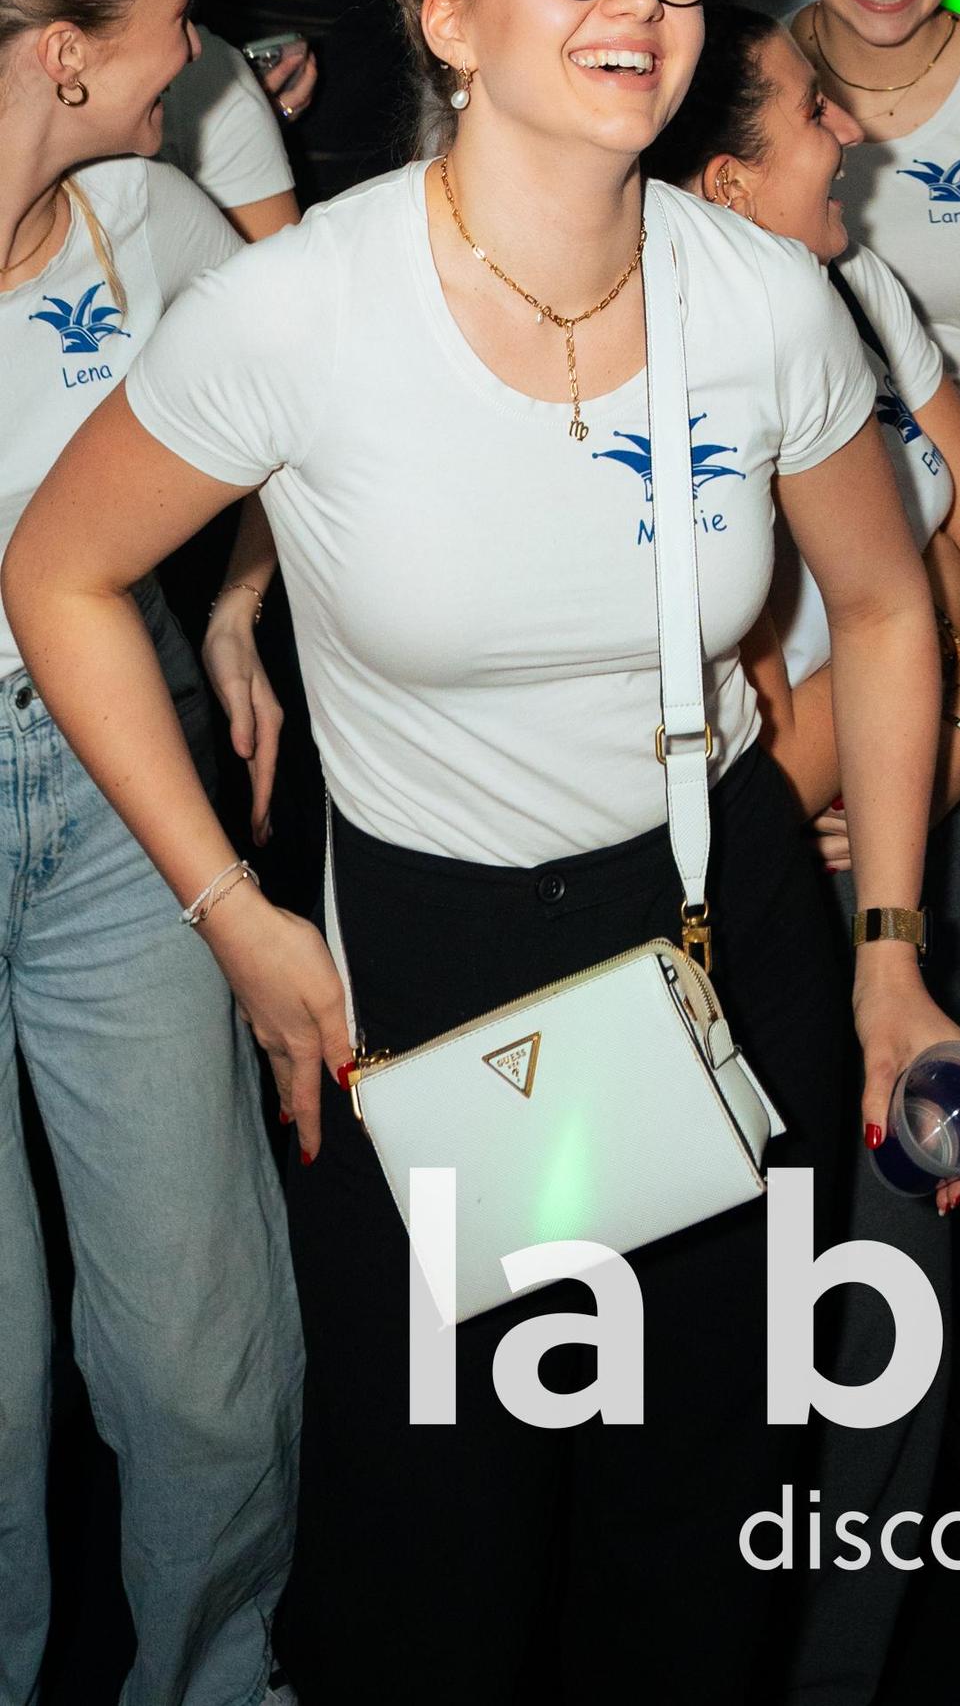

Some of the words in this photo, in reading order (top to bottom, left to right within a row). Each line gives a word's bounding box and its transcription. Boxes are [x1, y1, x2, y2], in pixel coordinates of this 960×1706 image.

[62, 363, 113, 389] Lena
[637, 509, 728, 546] Mie
[496, 1048, 527, 1068] GUESS
